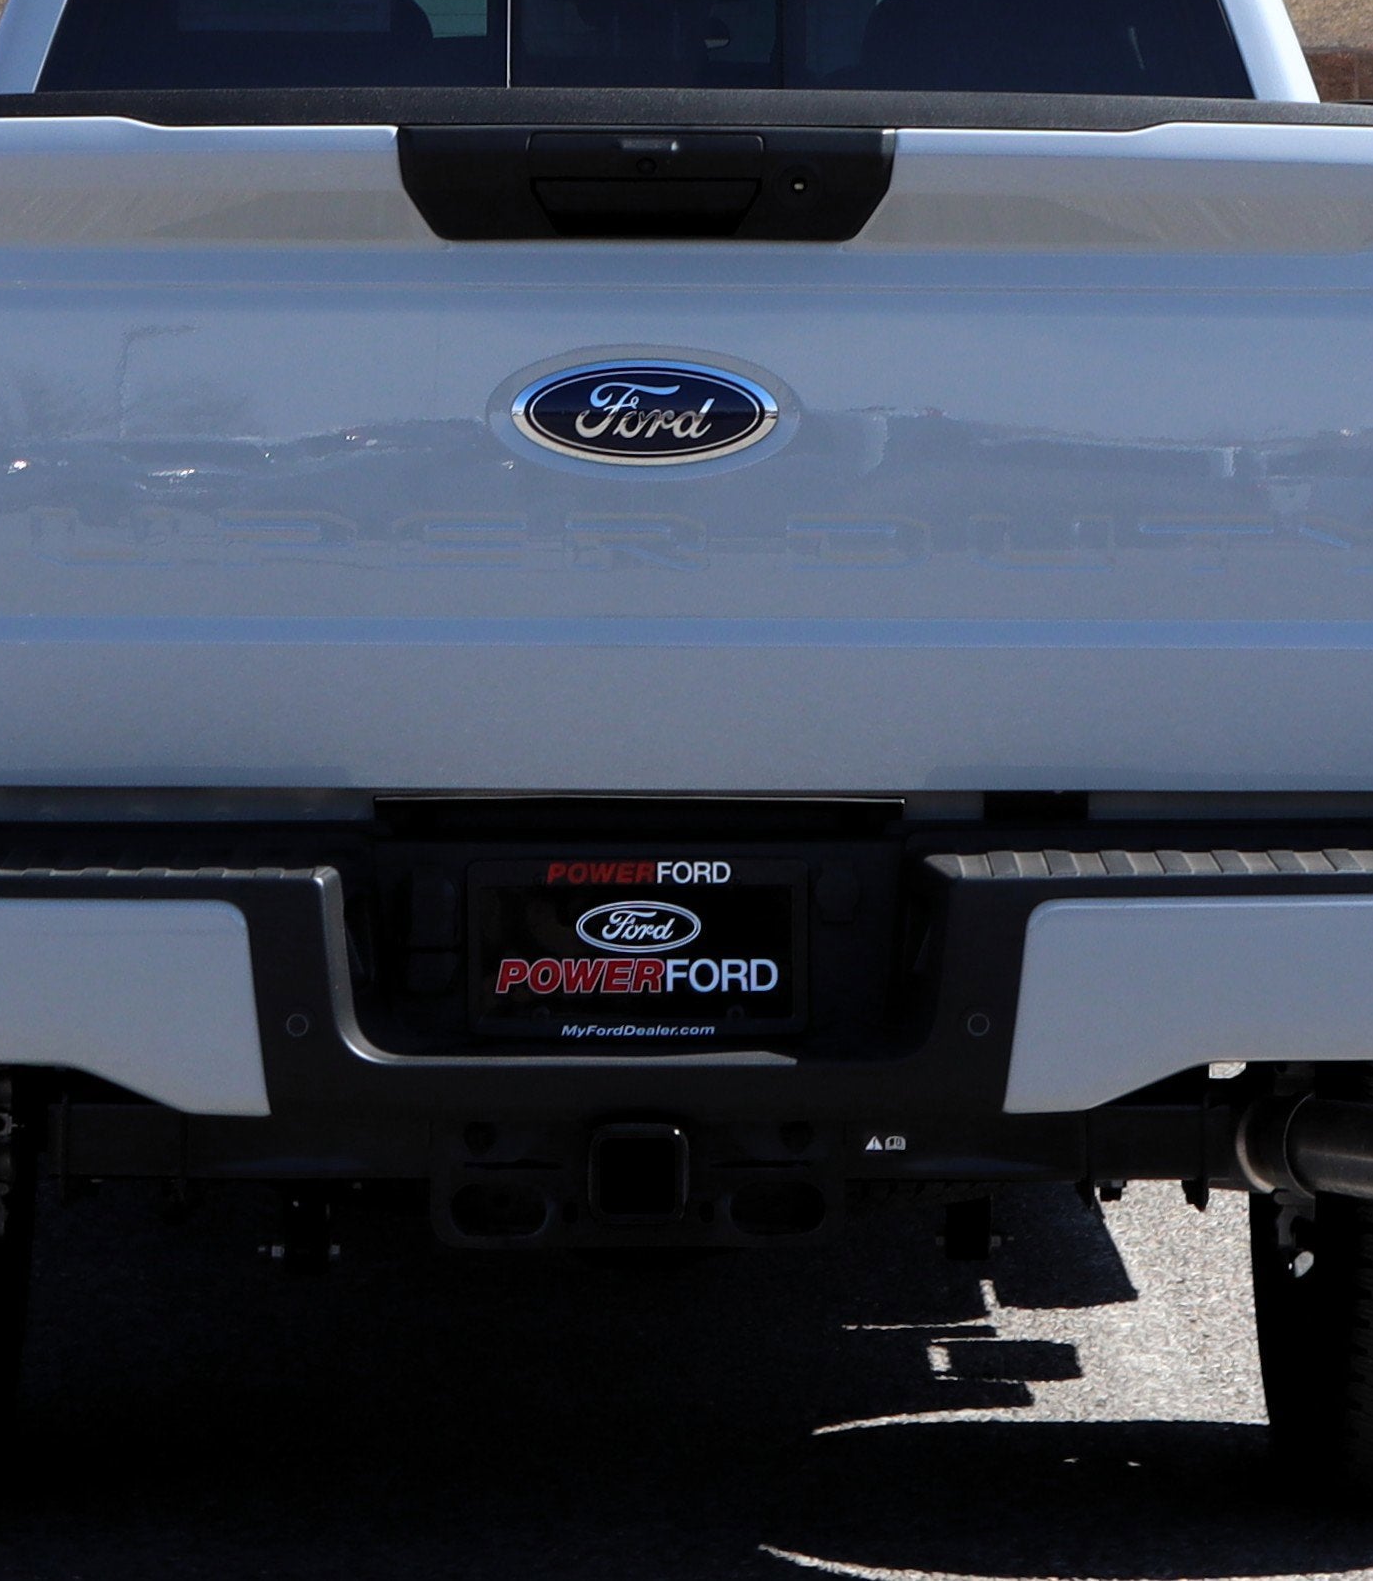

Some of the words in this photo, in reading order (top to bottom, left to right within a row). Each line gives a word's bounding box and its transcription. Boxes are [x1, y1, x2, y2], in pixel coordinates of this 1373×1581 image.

[576, 382, 715, 439] Ford
[546, 860, 732, 885] POWERFORD
[601, 909, 676, 941] Ford
[495, 958, 779, 994] POWERFORD
[561, 1024, 716, 1039] MyFordDealer.com
